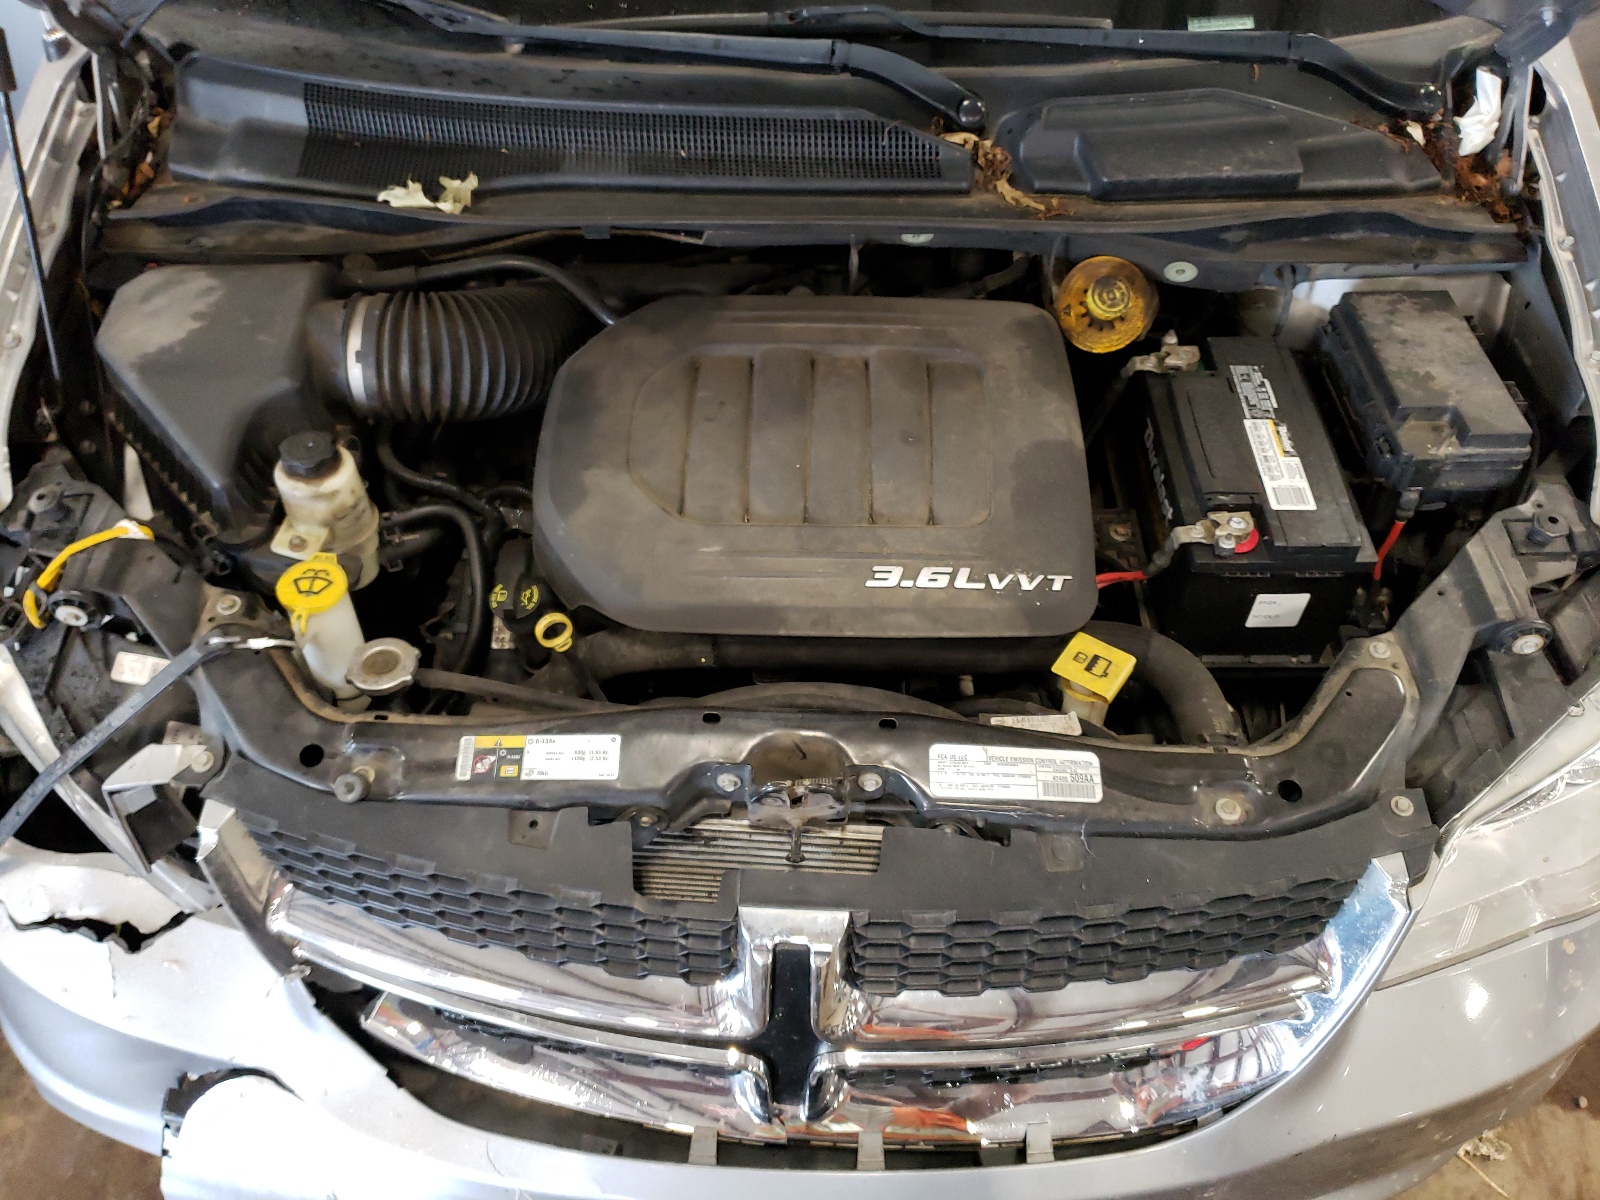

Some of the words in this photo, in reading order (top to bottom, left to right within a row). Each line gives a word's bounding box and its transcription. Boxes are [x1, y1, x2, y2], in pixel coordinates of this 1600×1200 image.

[988, 755, 1009, 763] VEHICLE
[1035, 757, 1058, 765] CONTROL
[1069, 773, 1095, 784] 509AA
